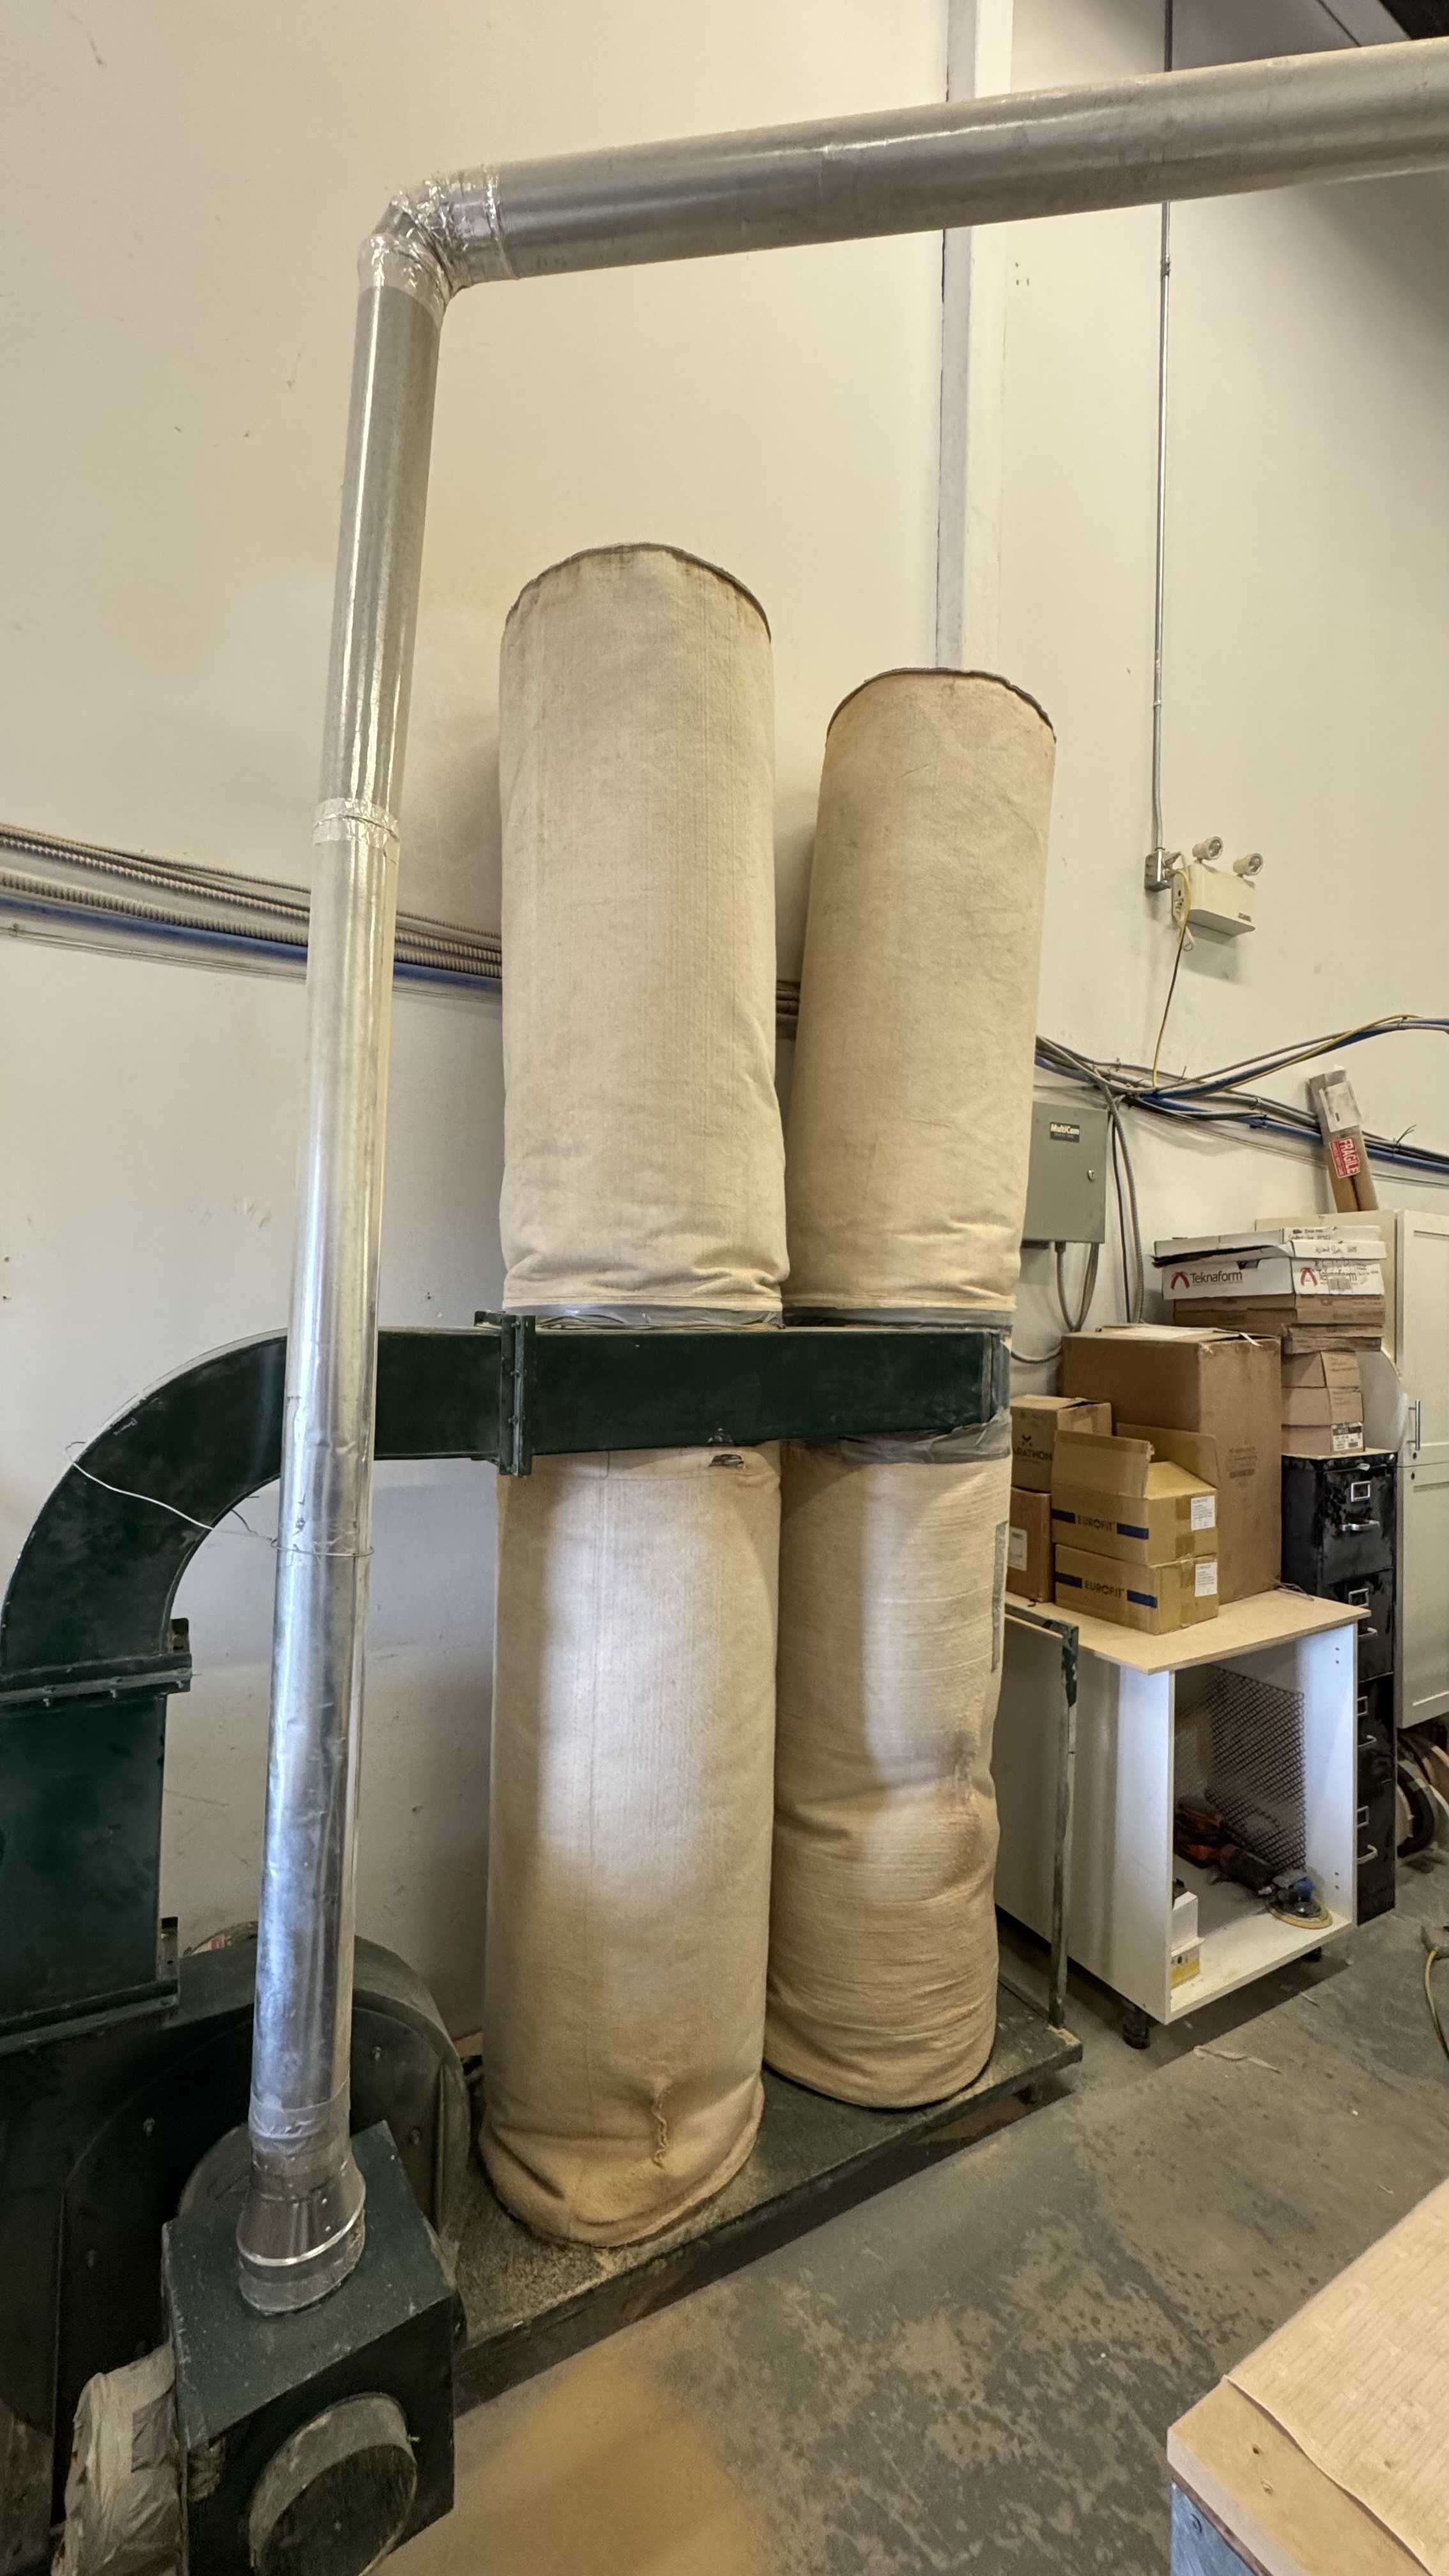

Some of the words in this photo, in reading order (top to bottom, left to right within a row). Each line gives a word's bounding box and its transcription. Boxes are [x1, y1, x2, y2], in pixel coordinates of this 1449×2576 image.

[1339, 1138, 1360, 1174] FRAGILE
[1190, 1270, 1243, 1284] Teknaform
[1013, 1447, 1053, 1460] ARATHON
[1078, 1515, 1113, 1531] EUROFIT
[1085, 1580, 1123, 1598] EUROFIT
